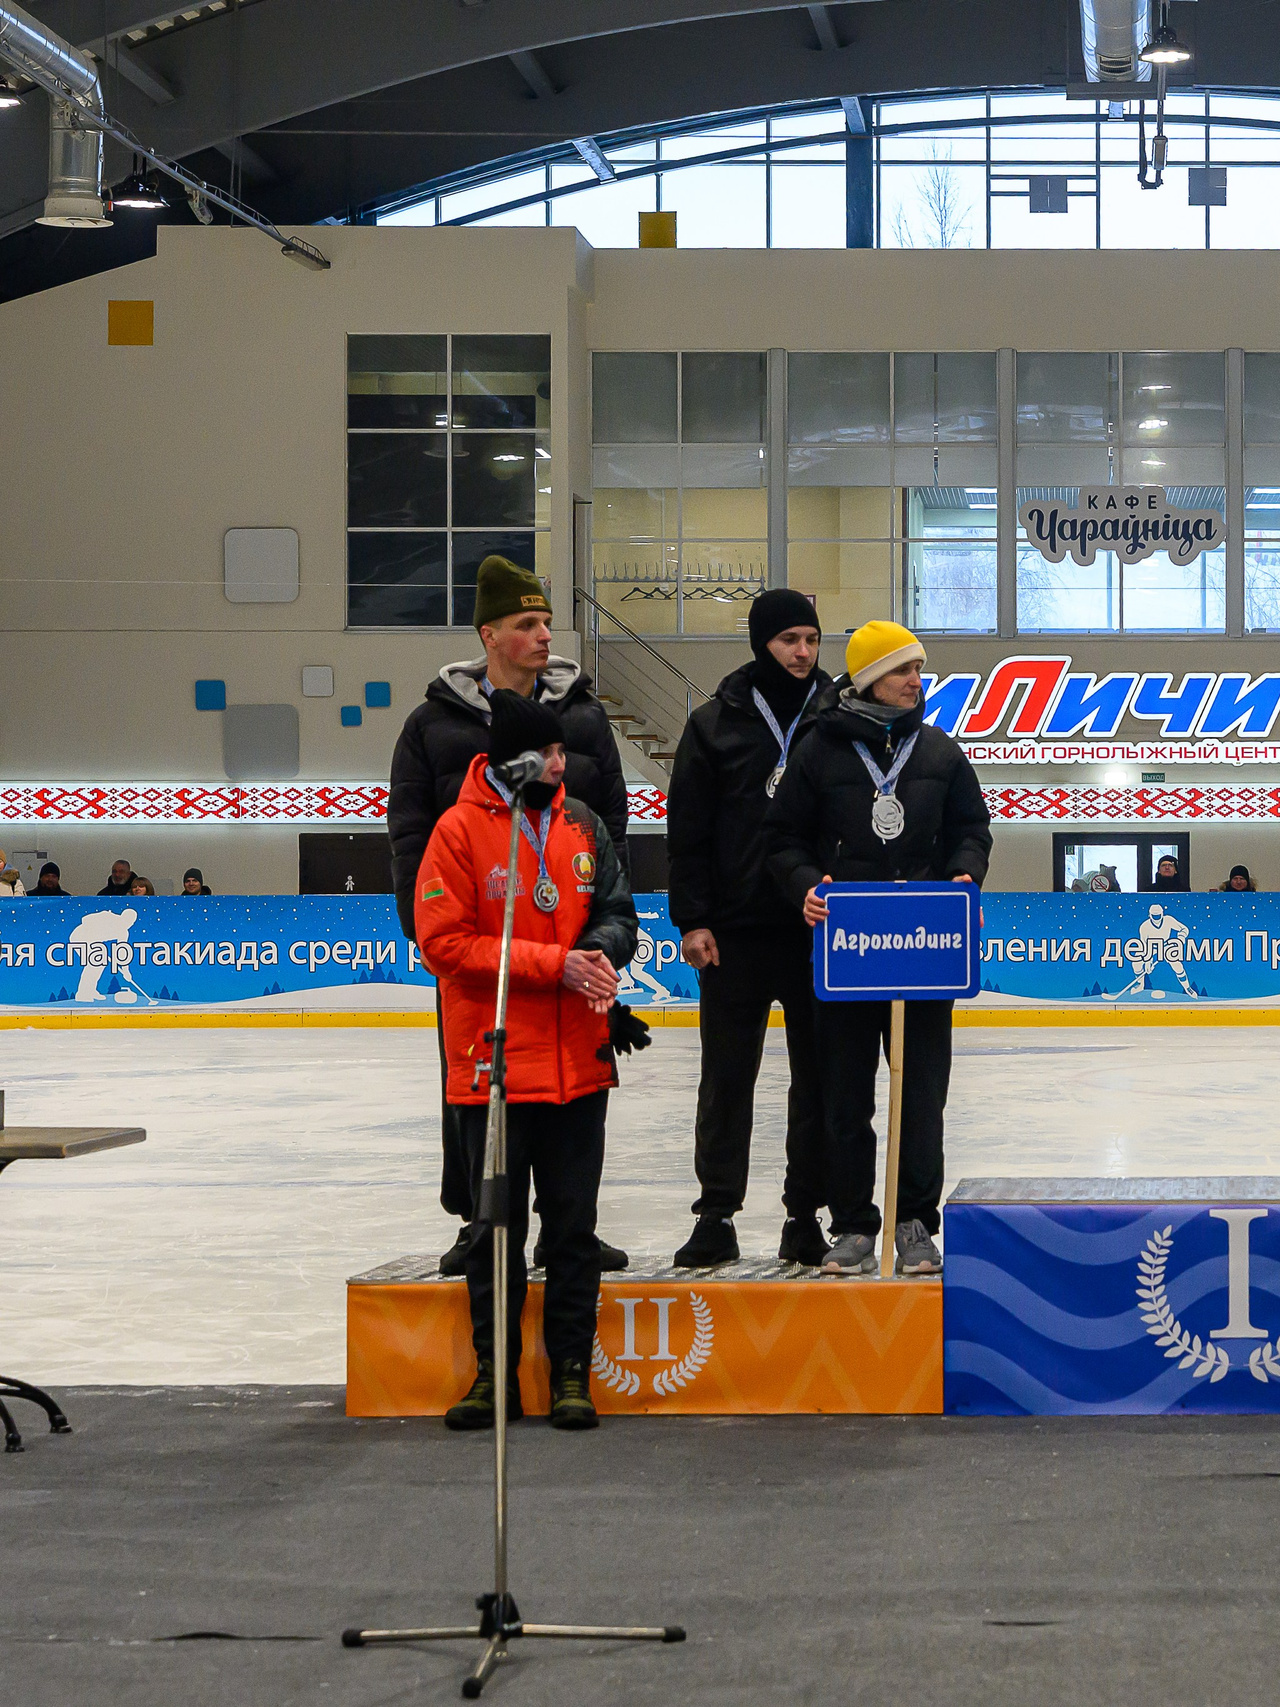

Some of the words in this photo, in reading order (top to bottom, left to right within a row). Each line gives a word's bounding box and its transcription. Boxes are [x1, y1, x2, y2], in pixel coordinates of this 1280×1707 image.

[1087, 494, 1158, 510] КАФЕ
[1028, 508, 1218, 557] Чараўніца
[1041, 743, 1219, 760] ГОРНОЛЫЖНЫЙ
[46, 940, 270, 973] спартакиада
[288, 940, 397, 973] среди
[1100, 936, 1234, 968] делами
[832, 926, 963, 957] Агрохолдинг
[614, 1297, 678, 1361] II
